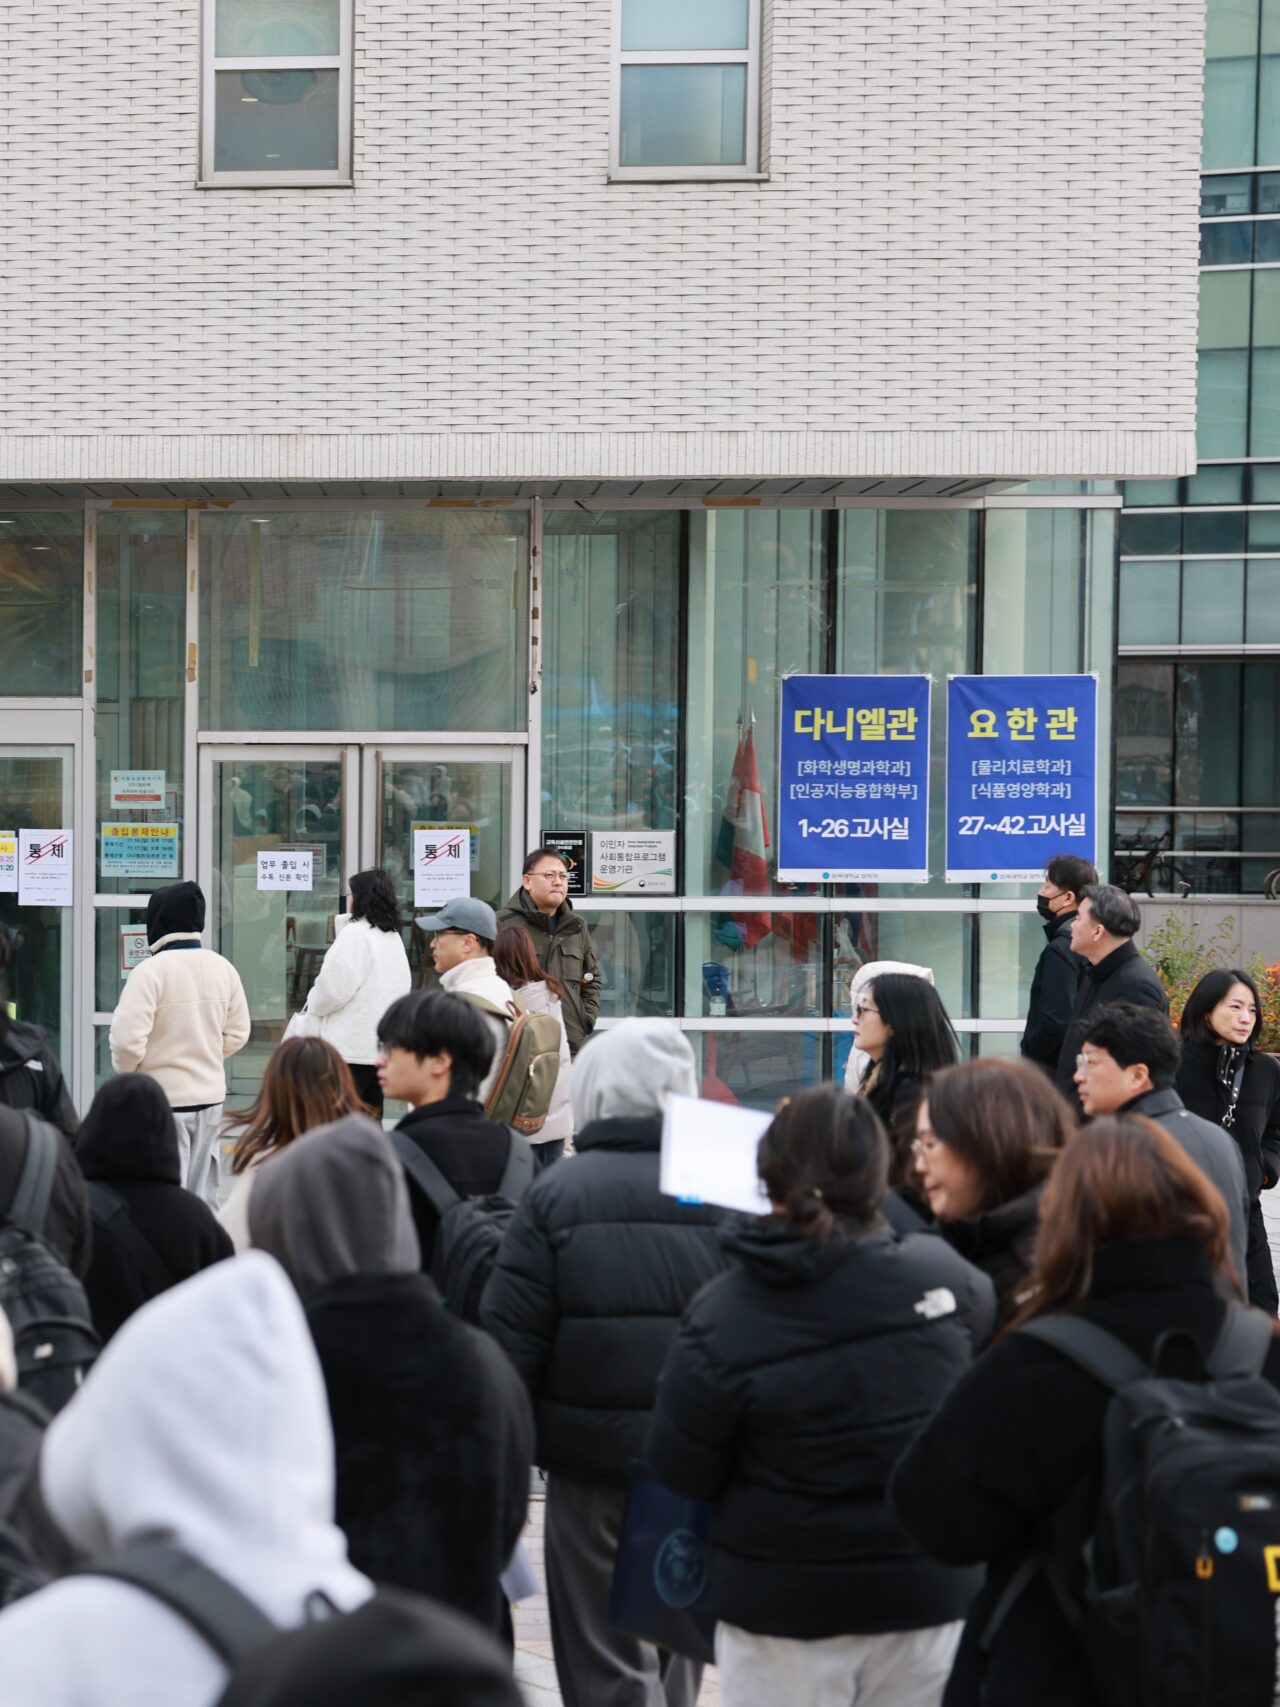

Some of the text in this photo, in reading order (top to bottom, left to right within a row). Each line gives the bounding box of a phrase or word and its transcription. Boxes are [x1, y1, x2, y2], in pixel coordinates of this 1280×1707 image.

[794, 707, 918, 741] 다니엘관
[798, 759, 911, 777] [화학생명과학과]
[971, 758, 1072, 776] [물리치료학과]
[790, 782, 918, 800] [인공지능융합학부]
[971, 782, 1072, 800] [식품영양학과]
[600, 840, 625, 849] 이민자
[281, 860, 296, 870] 출입
[302, 860, 309, 869] 시
[600, 852, 666, 861] 사회통합프로그램
[600, 864, 633, 874] 운영기관
